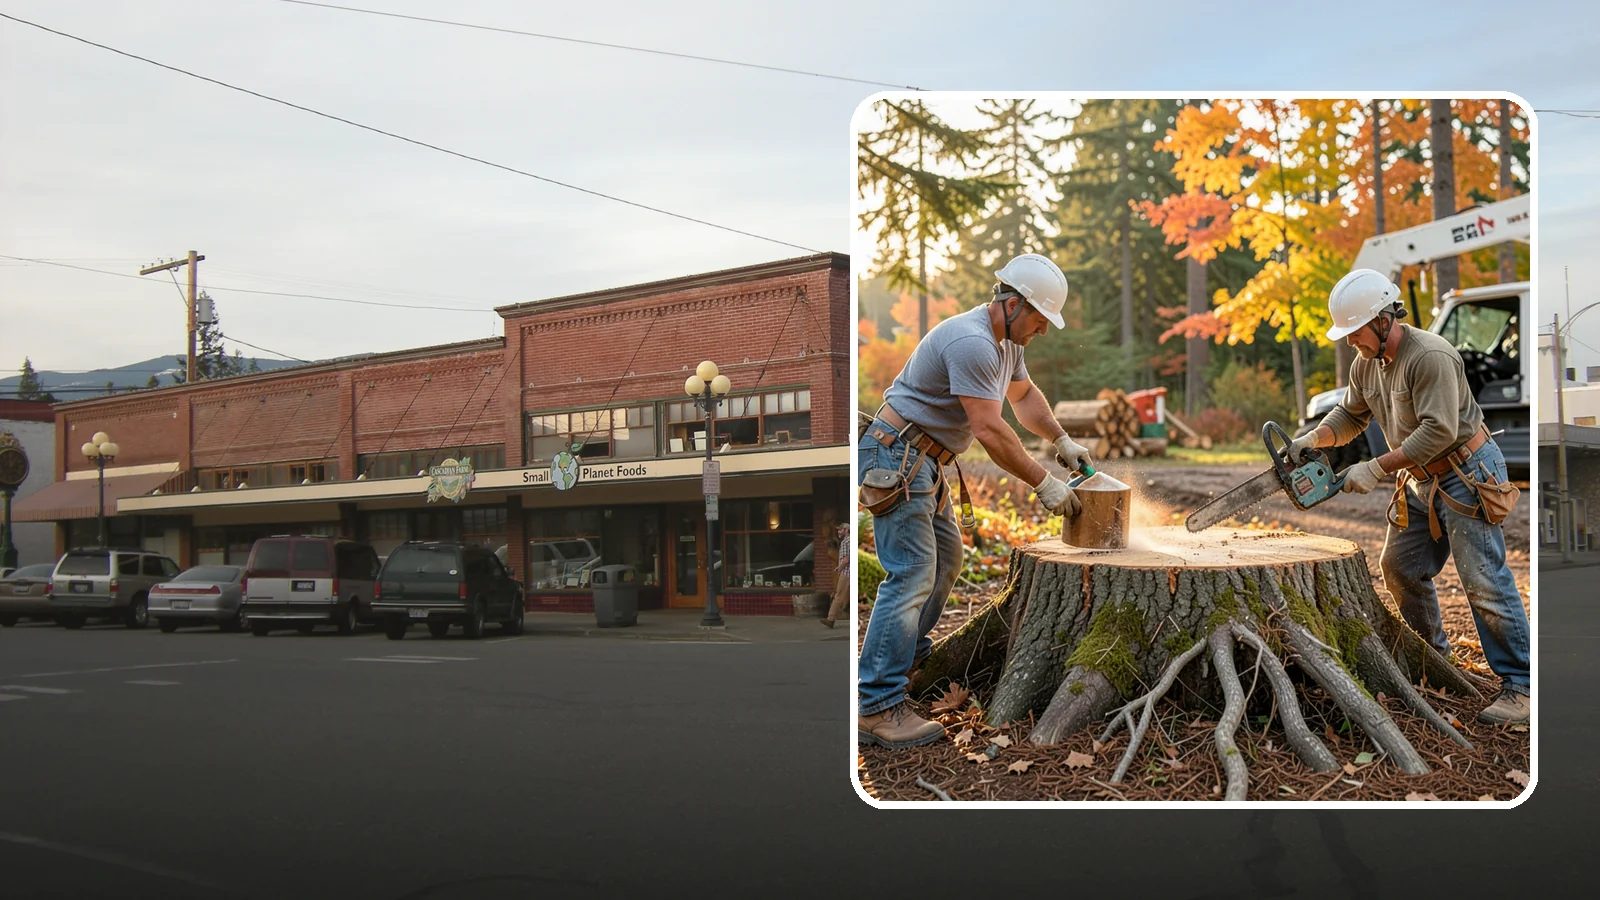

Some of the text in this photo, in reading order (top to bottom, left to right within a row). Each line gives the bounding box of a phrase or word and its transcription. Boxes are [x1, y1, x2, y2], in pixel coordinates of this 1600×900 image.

[523, 464, 647, 483] Small Planet Foods
